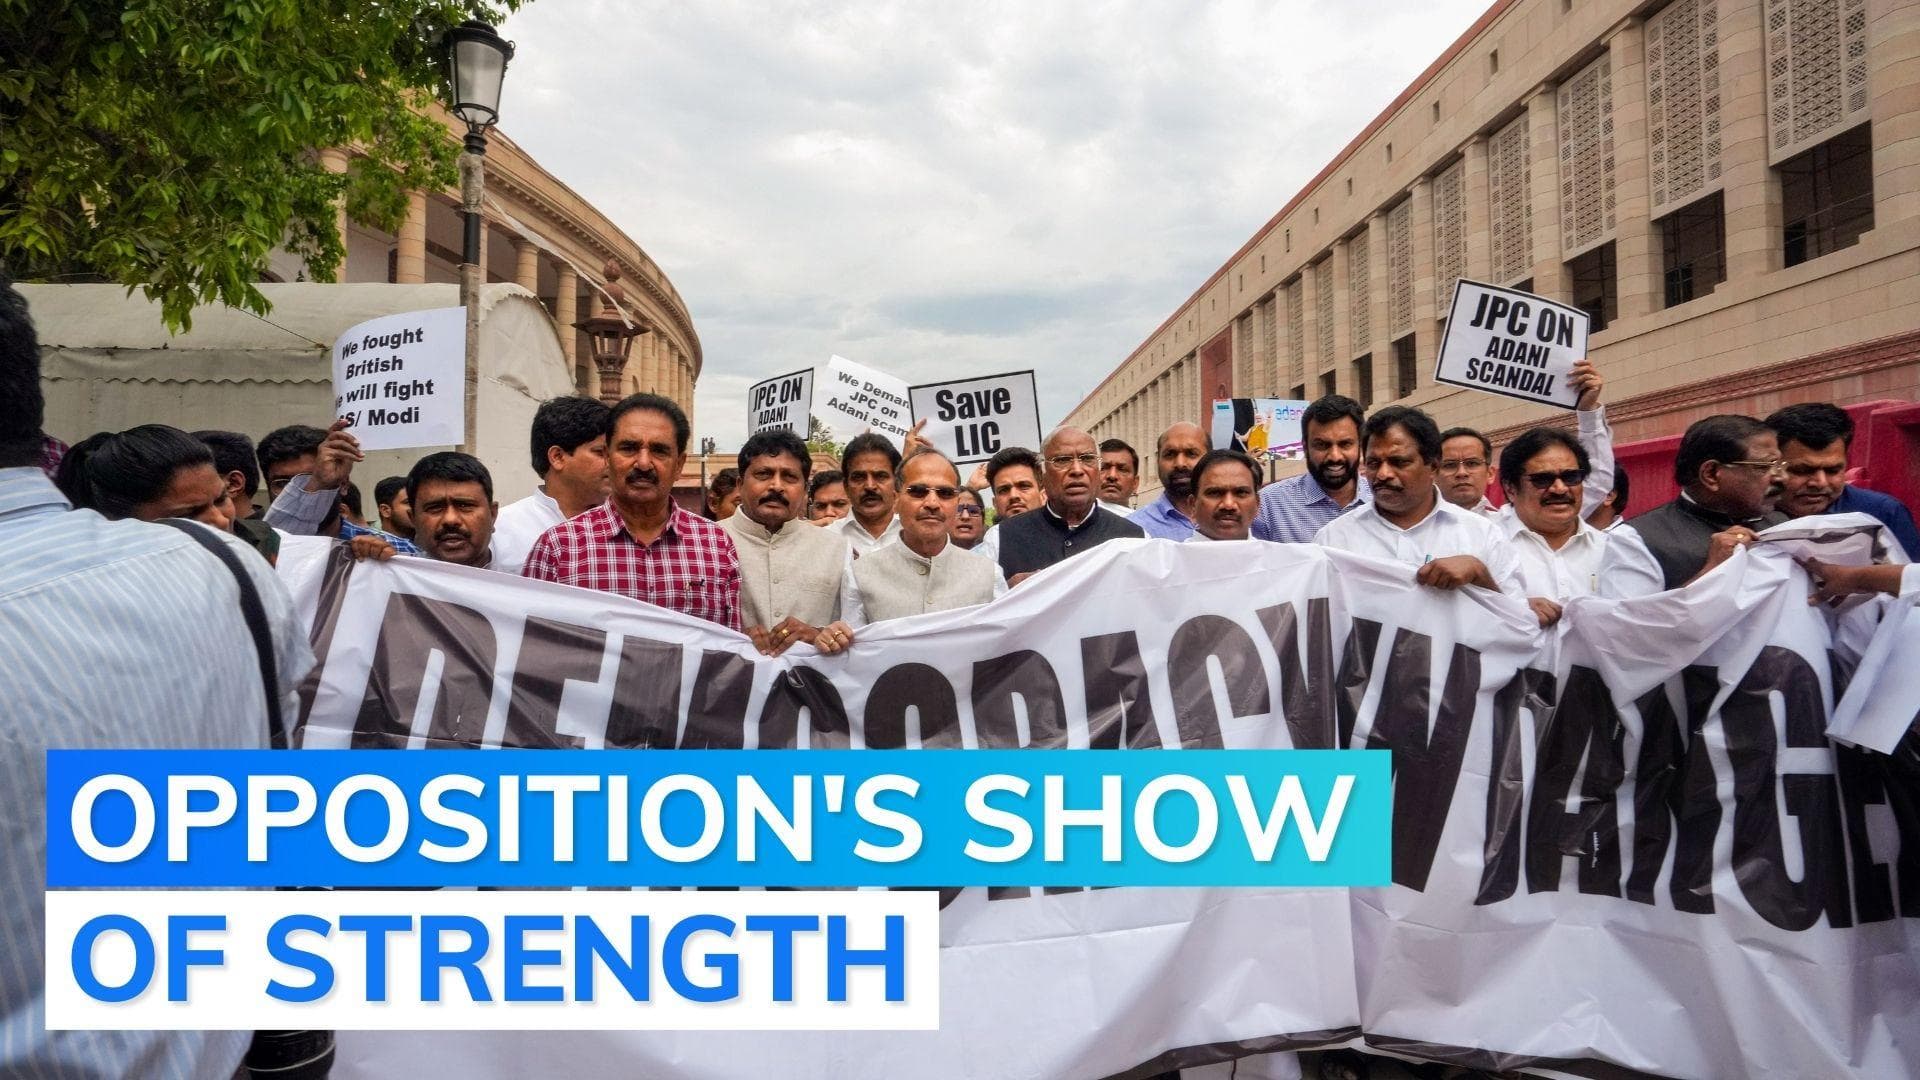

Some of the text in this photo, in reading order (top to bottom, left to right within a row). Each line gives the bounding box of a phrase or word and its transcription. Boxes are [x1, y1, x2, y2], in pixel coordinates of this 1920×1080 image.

[1470, 293, 1574, 348] JPC ON
[342, 327, 424, 360] We fought
[1484, 336, 1551, 369] ADANI
[346, 356, 404, 380] British
[838, 371, 859, 387] We
[1466, 357, 1555, 397] SCANDAL
[346, 383, 377, 403] will
[384, 379, 434, 401] fight
[753, 376, 803, 412] JPC ON
[850, 391, 898, 419] JPC on
[935, 387, 1012, 422] Save
[368, 406, 420, 426] Modi
[758, 405, 788, 427] ADANI
[827, 397, 869, 422] Adani
[954, 421, 1001, 457] LIC
[1473, 646, 1920, 932] DANGE
